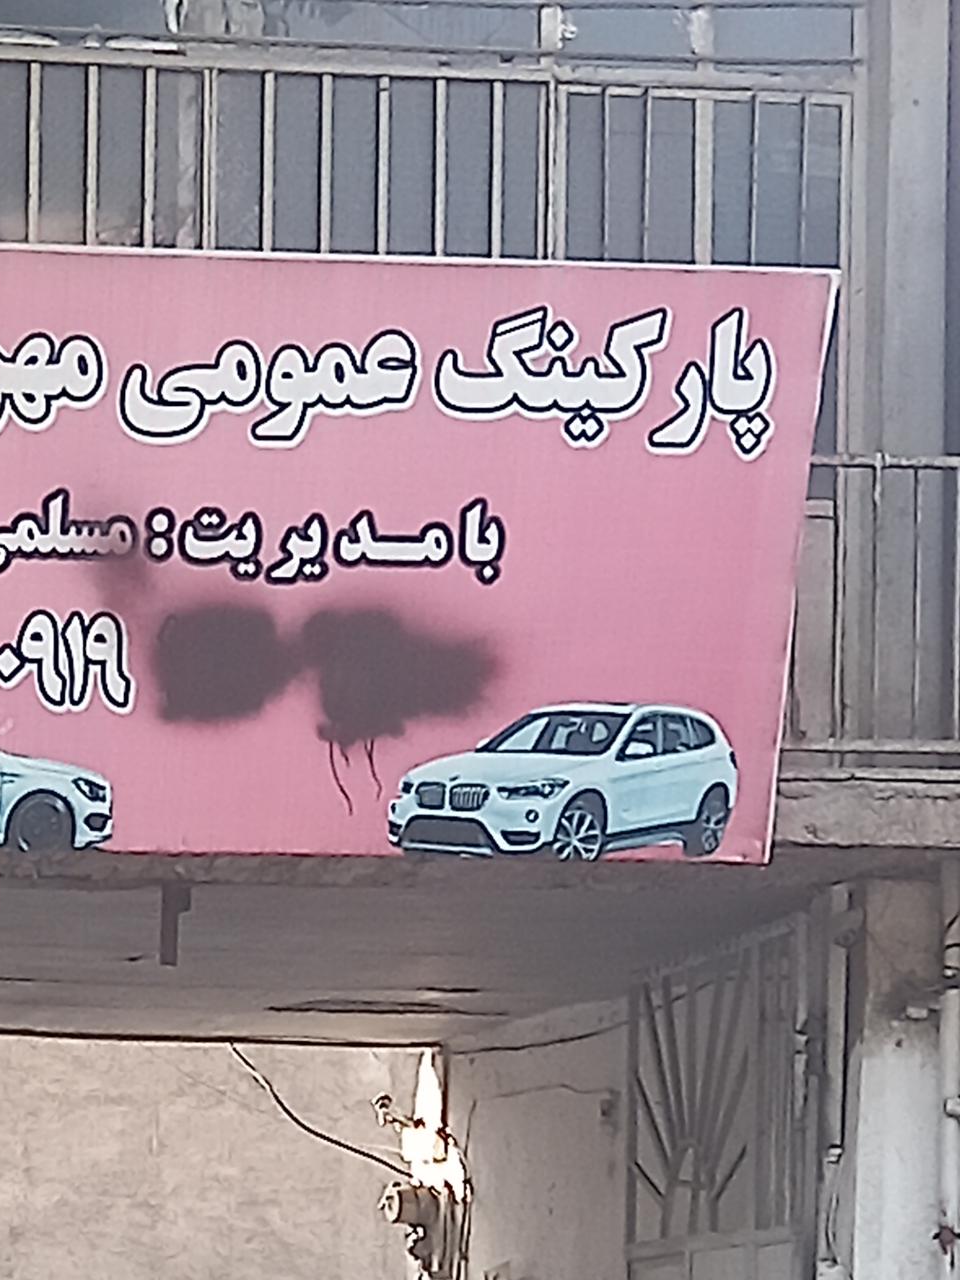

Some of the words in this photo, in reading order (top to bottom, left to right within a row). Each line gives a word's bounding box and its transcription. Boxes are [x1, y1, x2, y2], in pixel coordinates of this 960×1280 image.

[119, 328, 417, 440] عمومی
[434, 305, 772, 455] پارکینگ
[459, 498, 505, 585] با
